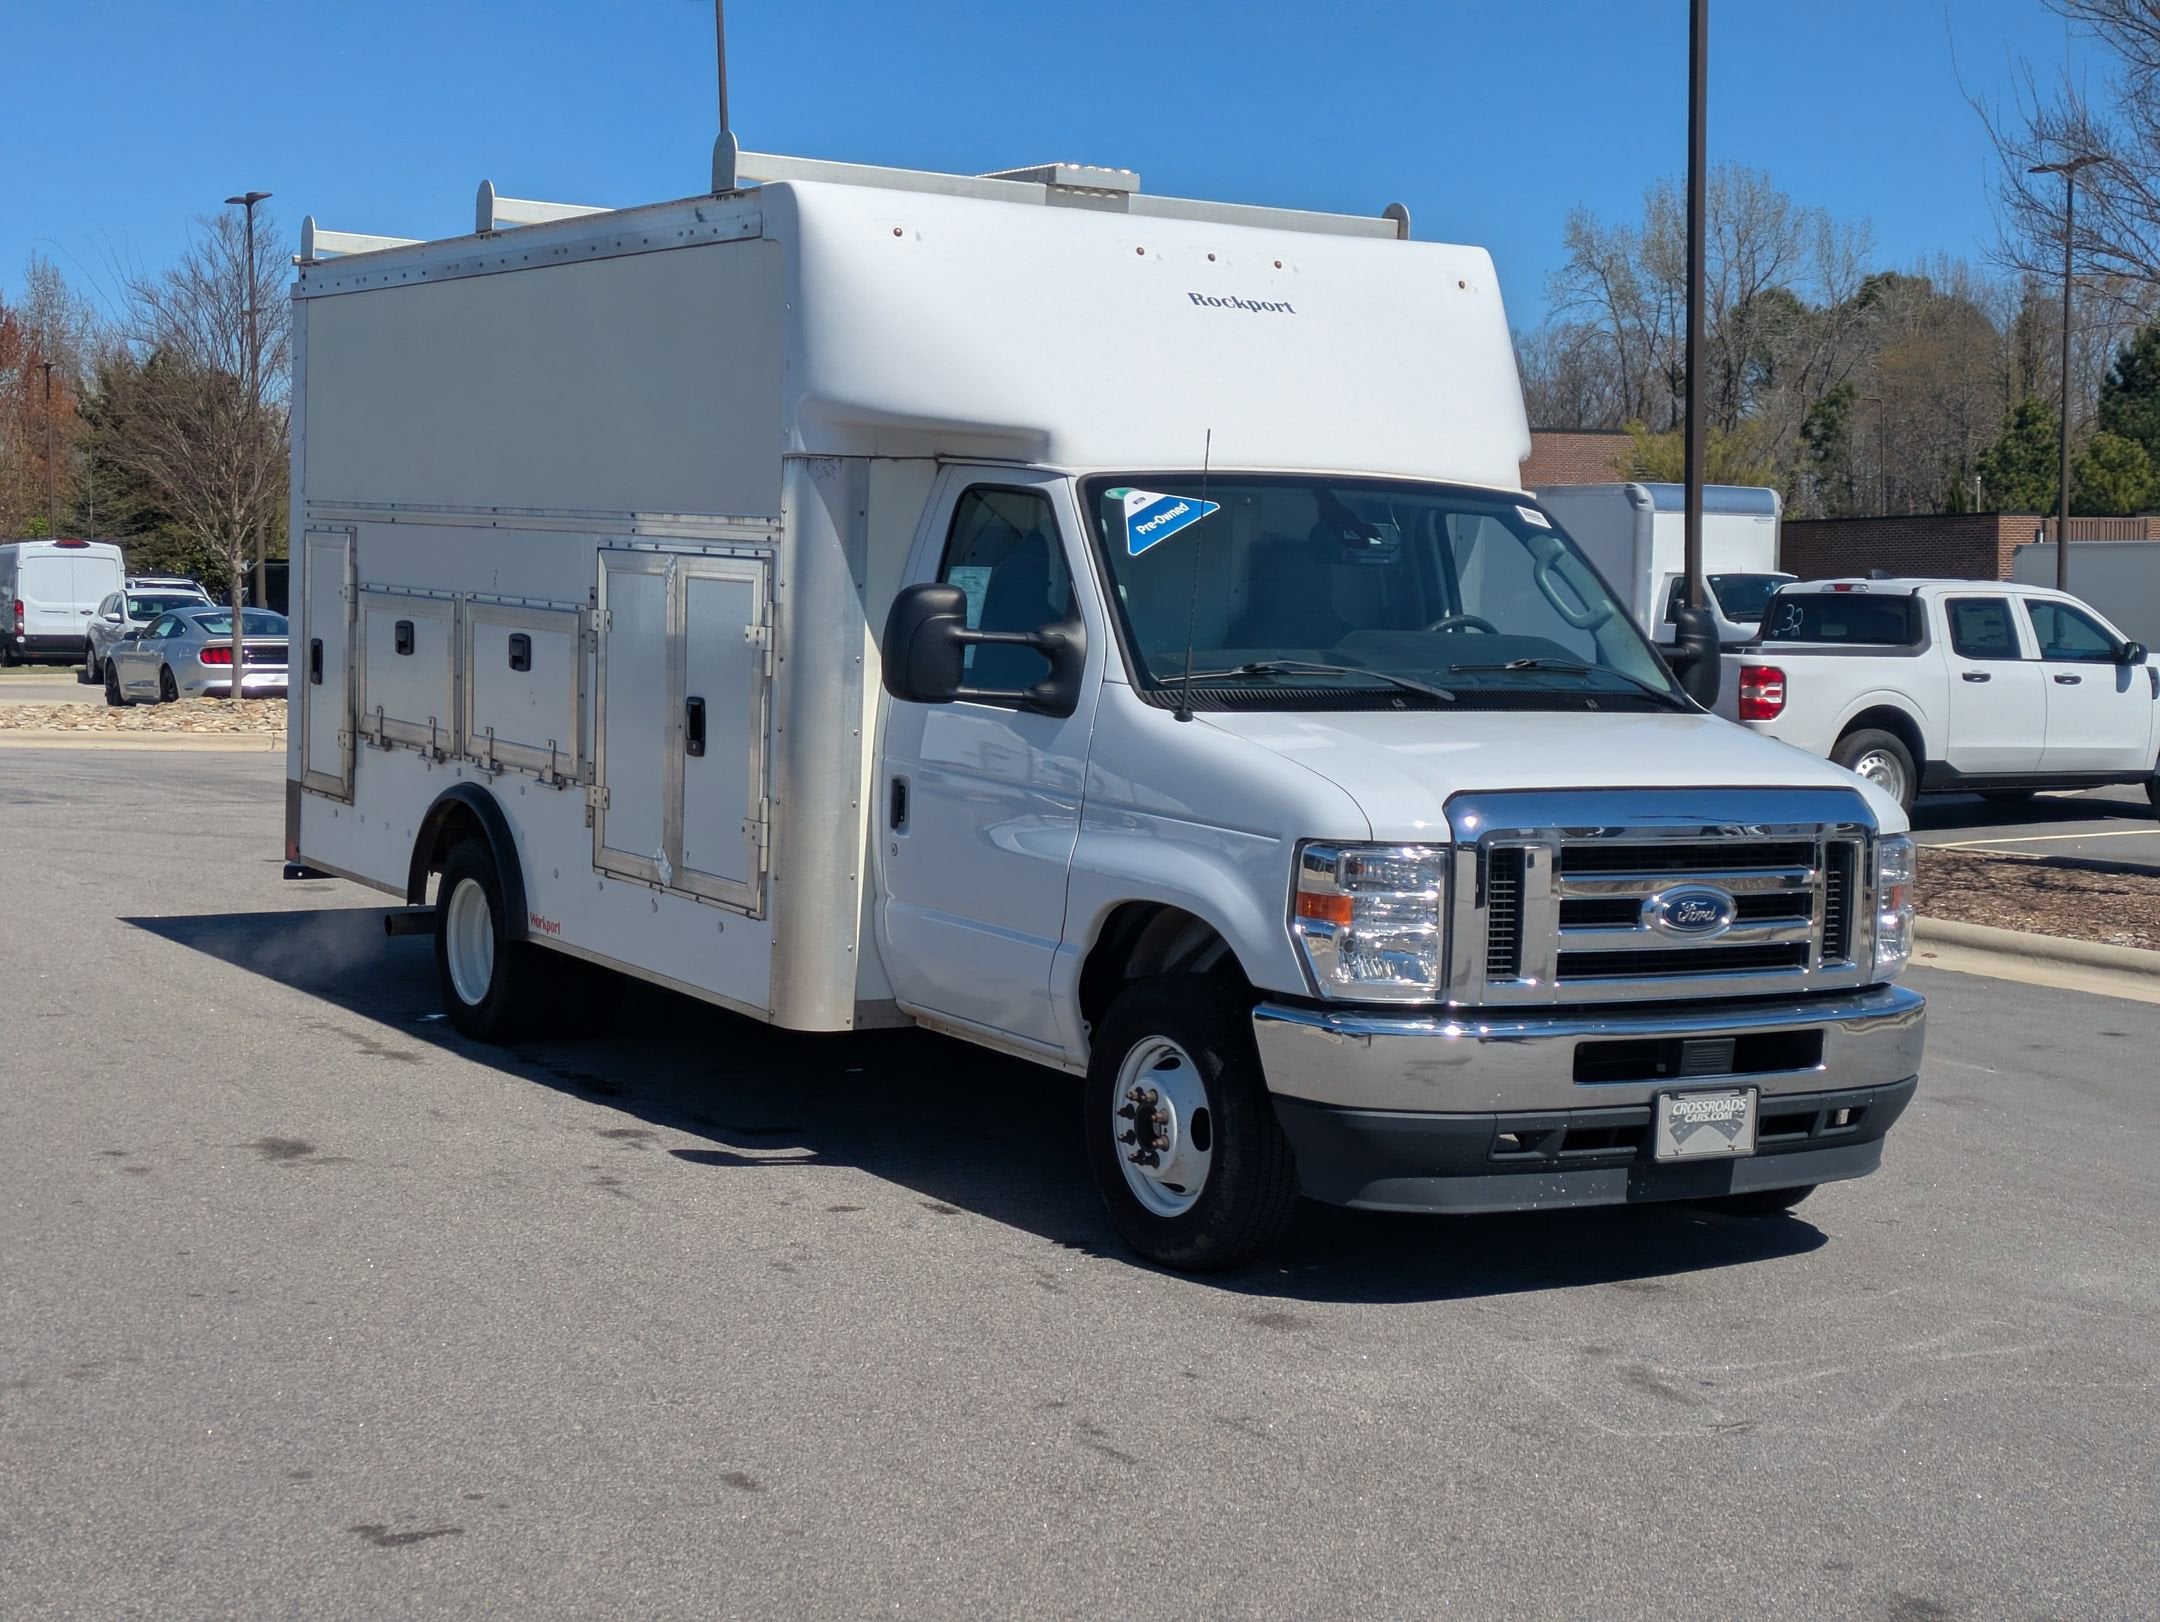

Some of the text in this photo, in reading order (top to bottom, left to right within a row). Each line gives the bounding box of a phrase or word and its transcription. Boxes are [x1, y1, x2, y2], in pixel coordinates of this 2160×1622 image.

[1187, 292, 1297, 314] Rockport
[1135, 501, 1190, 535] Pre-Owned
[1677, 901, 1717, 922] Ford
[529, 911, 561, 935] Workport
[1672, 1098, 1747, 1116] CROSSROADS
[1684, 1111, 1733, 1123] CARS.COM
